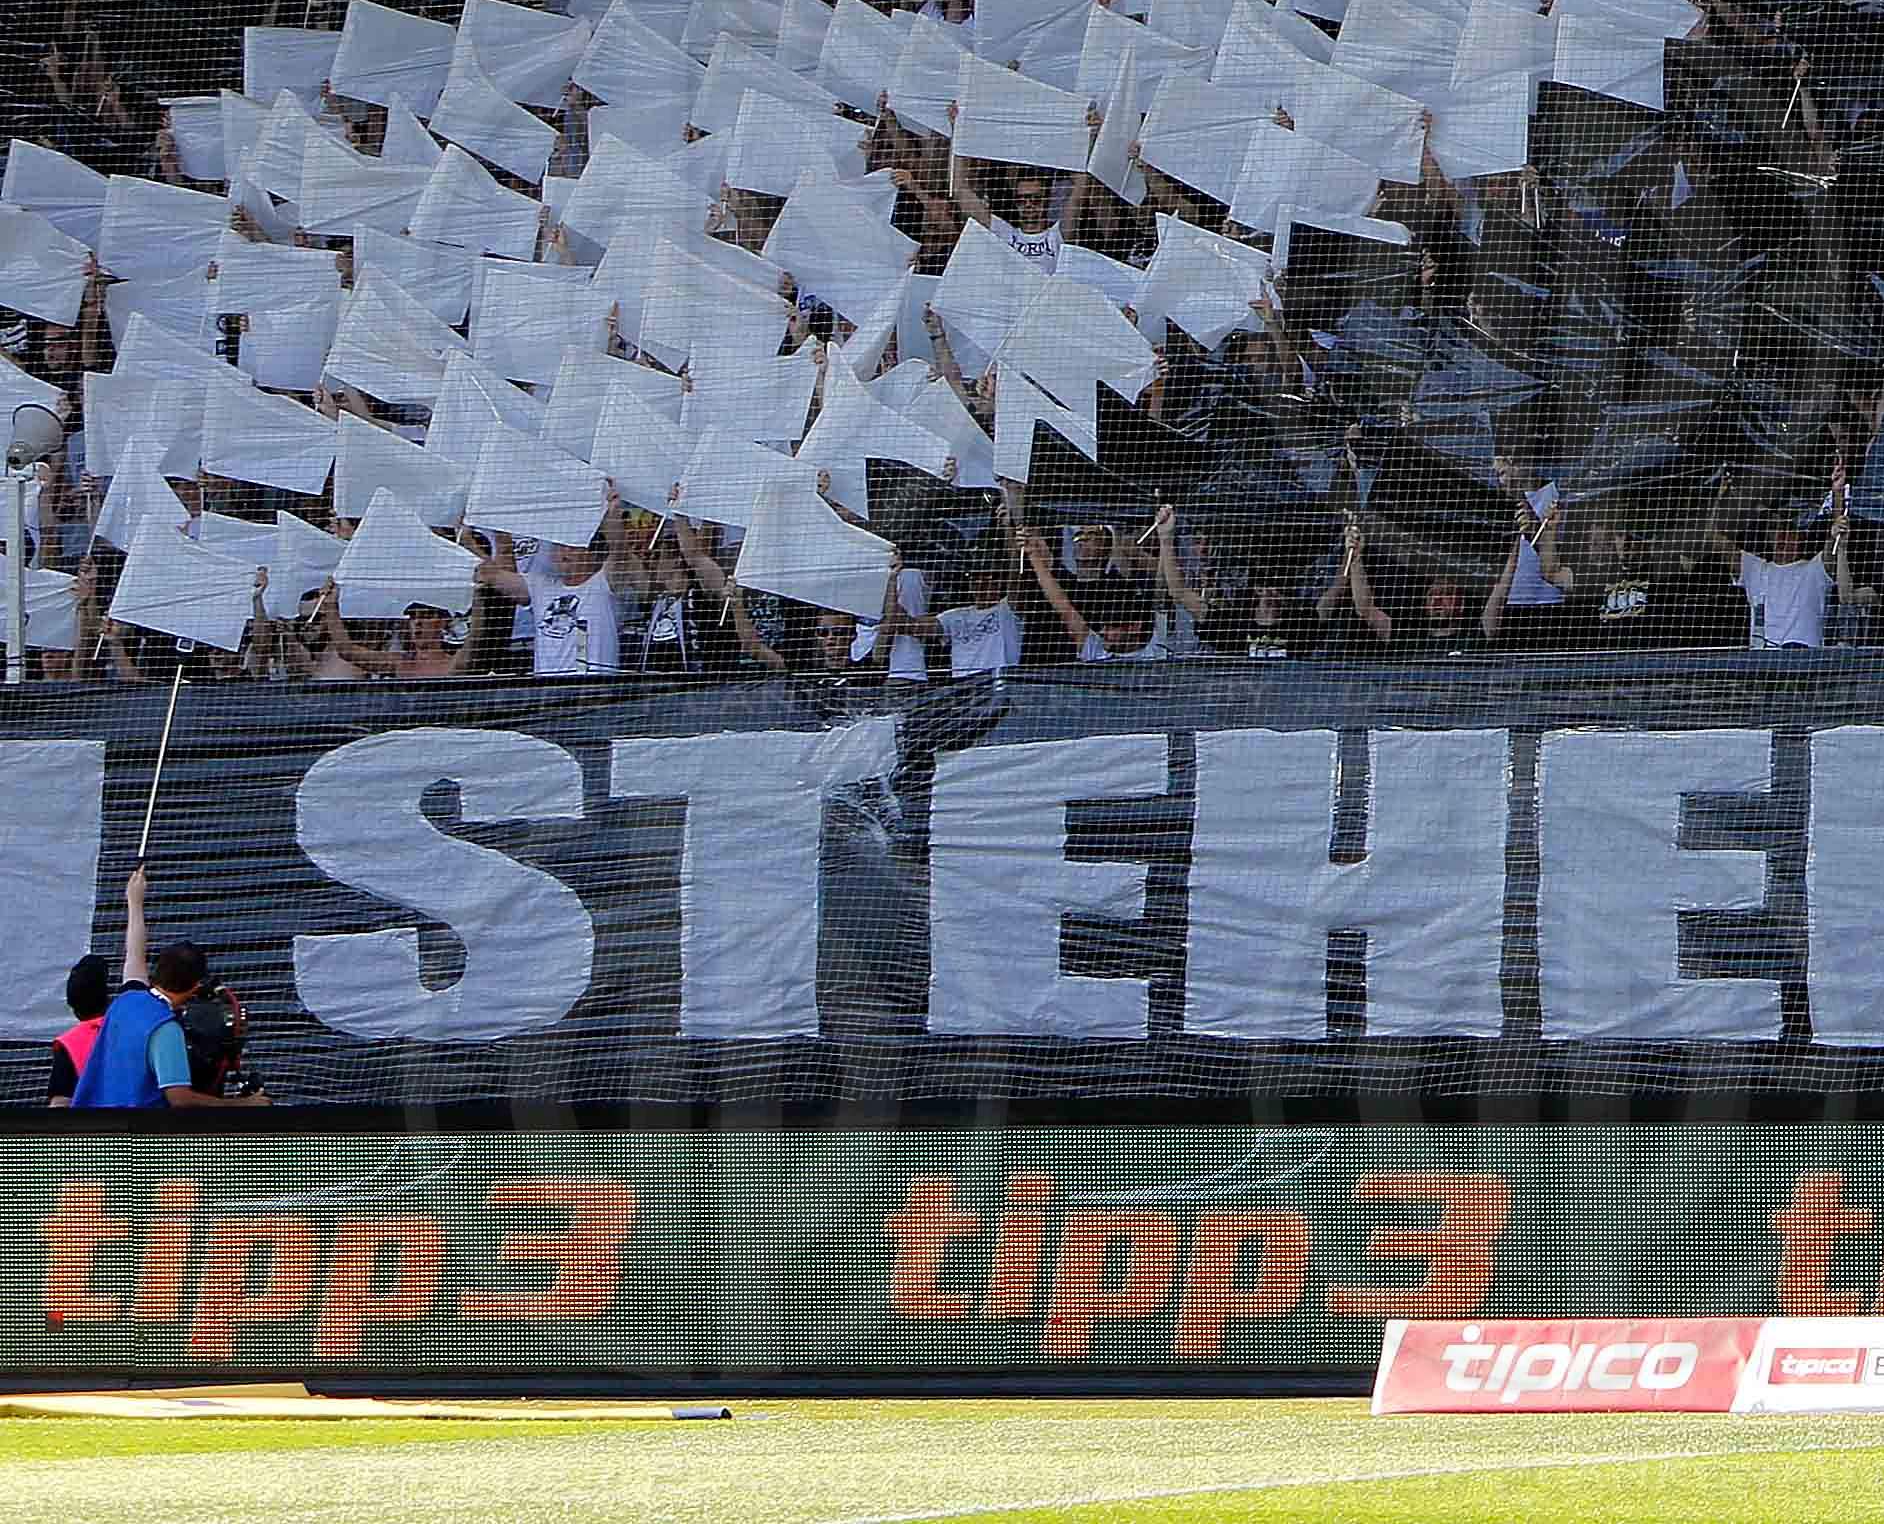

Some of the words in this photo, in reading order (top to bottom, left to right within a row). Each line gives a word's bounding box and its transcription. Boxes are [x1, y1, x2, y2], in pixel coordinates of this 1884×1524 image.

[43, 1177, 640, 1360] tipp3
[888, 1173, 1508, 1360] tipp3
[1442, 1324, 1699, 1396] tipico
[1778, 1349, 1857, 1379] tipico
